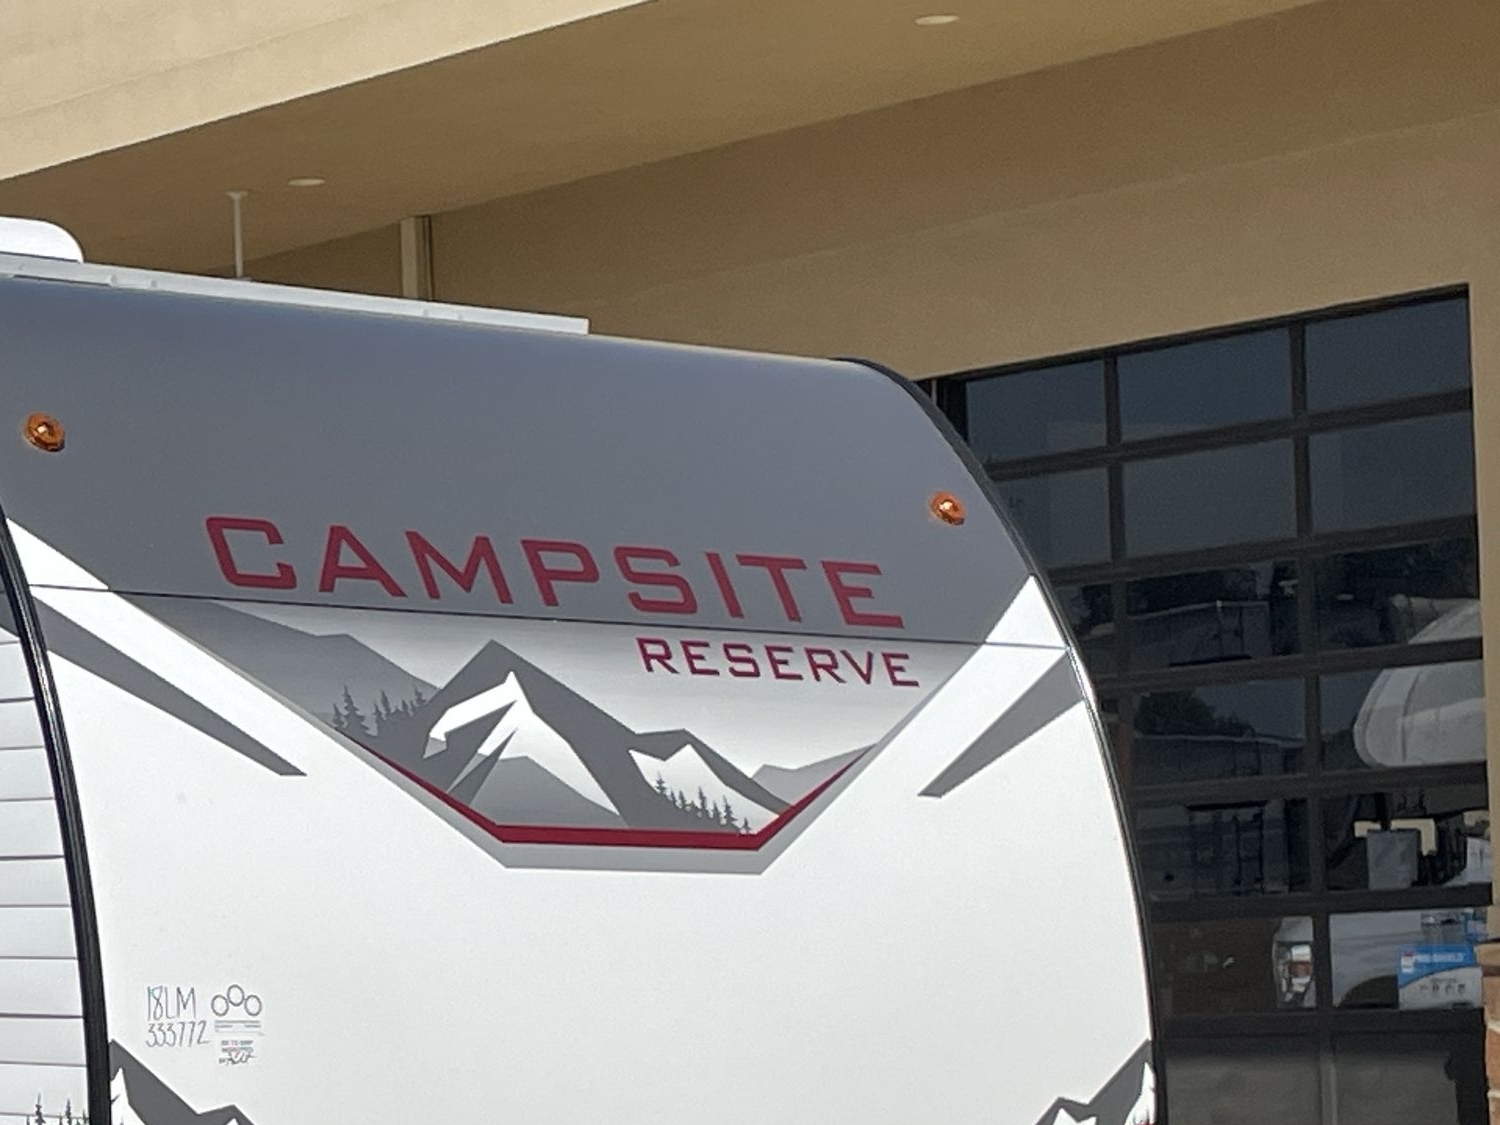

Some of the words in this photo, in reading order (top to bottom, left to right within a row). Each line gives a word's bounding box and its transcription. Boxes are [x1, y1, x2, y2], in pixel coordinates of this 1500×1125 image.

[205, 515, 905, 629] CAMPSITE
[636, 636, 920, 688] RESERVE
[146, 985, 197, 1021] 18LM
